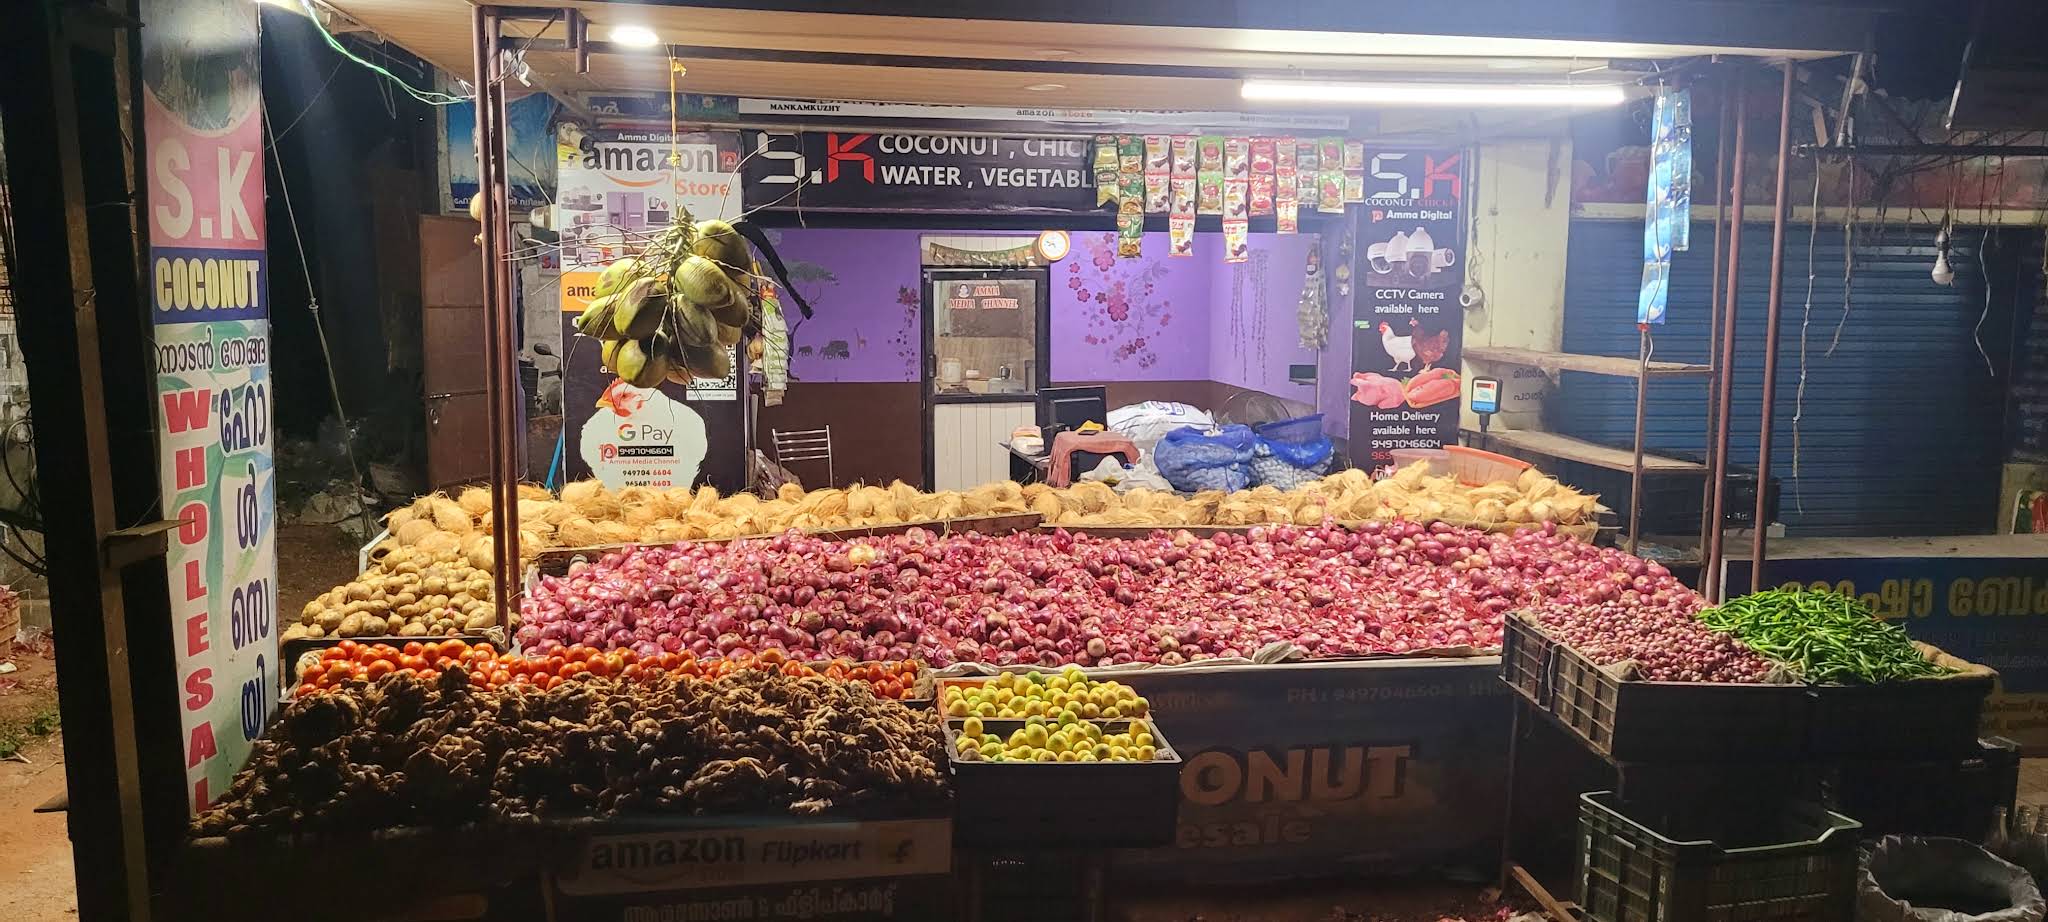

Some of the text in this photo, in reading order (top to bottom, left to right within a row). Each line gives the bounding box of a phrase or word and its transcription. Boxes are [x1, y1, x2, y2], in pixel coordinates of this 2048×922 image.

[770, 104, 840, 112] MANKAMKUZHY
[1016, 108, 1055, 117] amazon
[649, 133, 679, 143] Digitl
[878, 135, 998, 156] COCONUT
[582, 145, 714, 173] amazon
[757, 130, 874, 184] S.K
[881, 166, 961, 185] WATER
[1371, 153, 1461, 199] S.K
[155, 137, 258, 240] S.K
[676, 180, 730, 196] Store
[1365, 198, 1413, 207] COCONUT
[1386, 210, 1452, 220] Amma Digital
[155, 257, 260, 312] COCONUT
[973, 285, 1000, 297] AMMA
[1375, 289, 1444, 299] CCTV Camera
[950, 298, 1018, 309] MEDIA CHANNEL
[1374, 304, 1439, 313] available here
[1370, 411, 1440, 424] Home Delivery
[642, 424, 673, 444] Pay
[1372, 426, 1436, 435] available here
[1371, 439, 1441, 448] 9497046604
[619, 447, 672, 455] 9497046604
[654, 457, 680, 465] Channel
[592, 837, 744, 871] amazon
[761, 840, 863, 865] Flipkart
